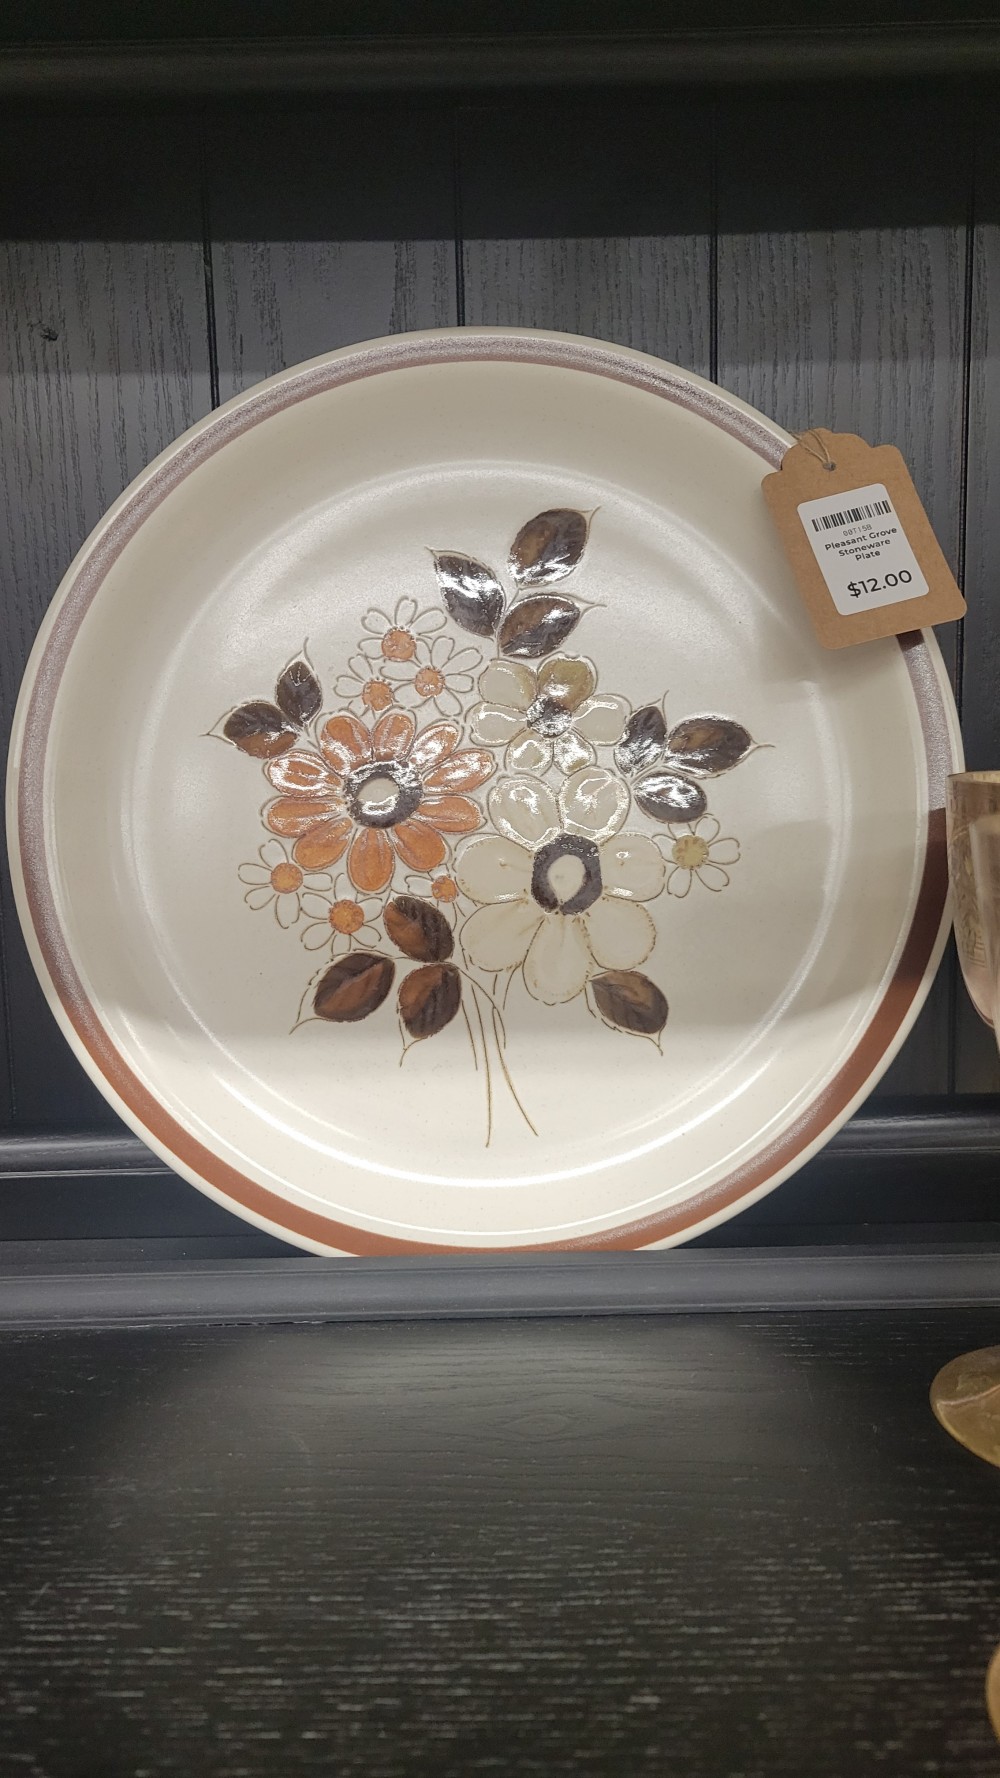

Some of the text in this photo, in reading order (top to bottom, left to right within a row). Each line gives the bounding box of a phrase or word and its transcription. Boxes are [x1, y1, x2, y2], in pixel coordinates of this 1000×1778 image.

[825, 528, 897, 550] Pleasant Grove
[838, 539, 891, 557] Stoneware
[855, 550, 881, 561] Plate
[847, 570, 912, 598] $12.00
